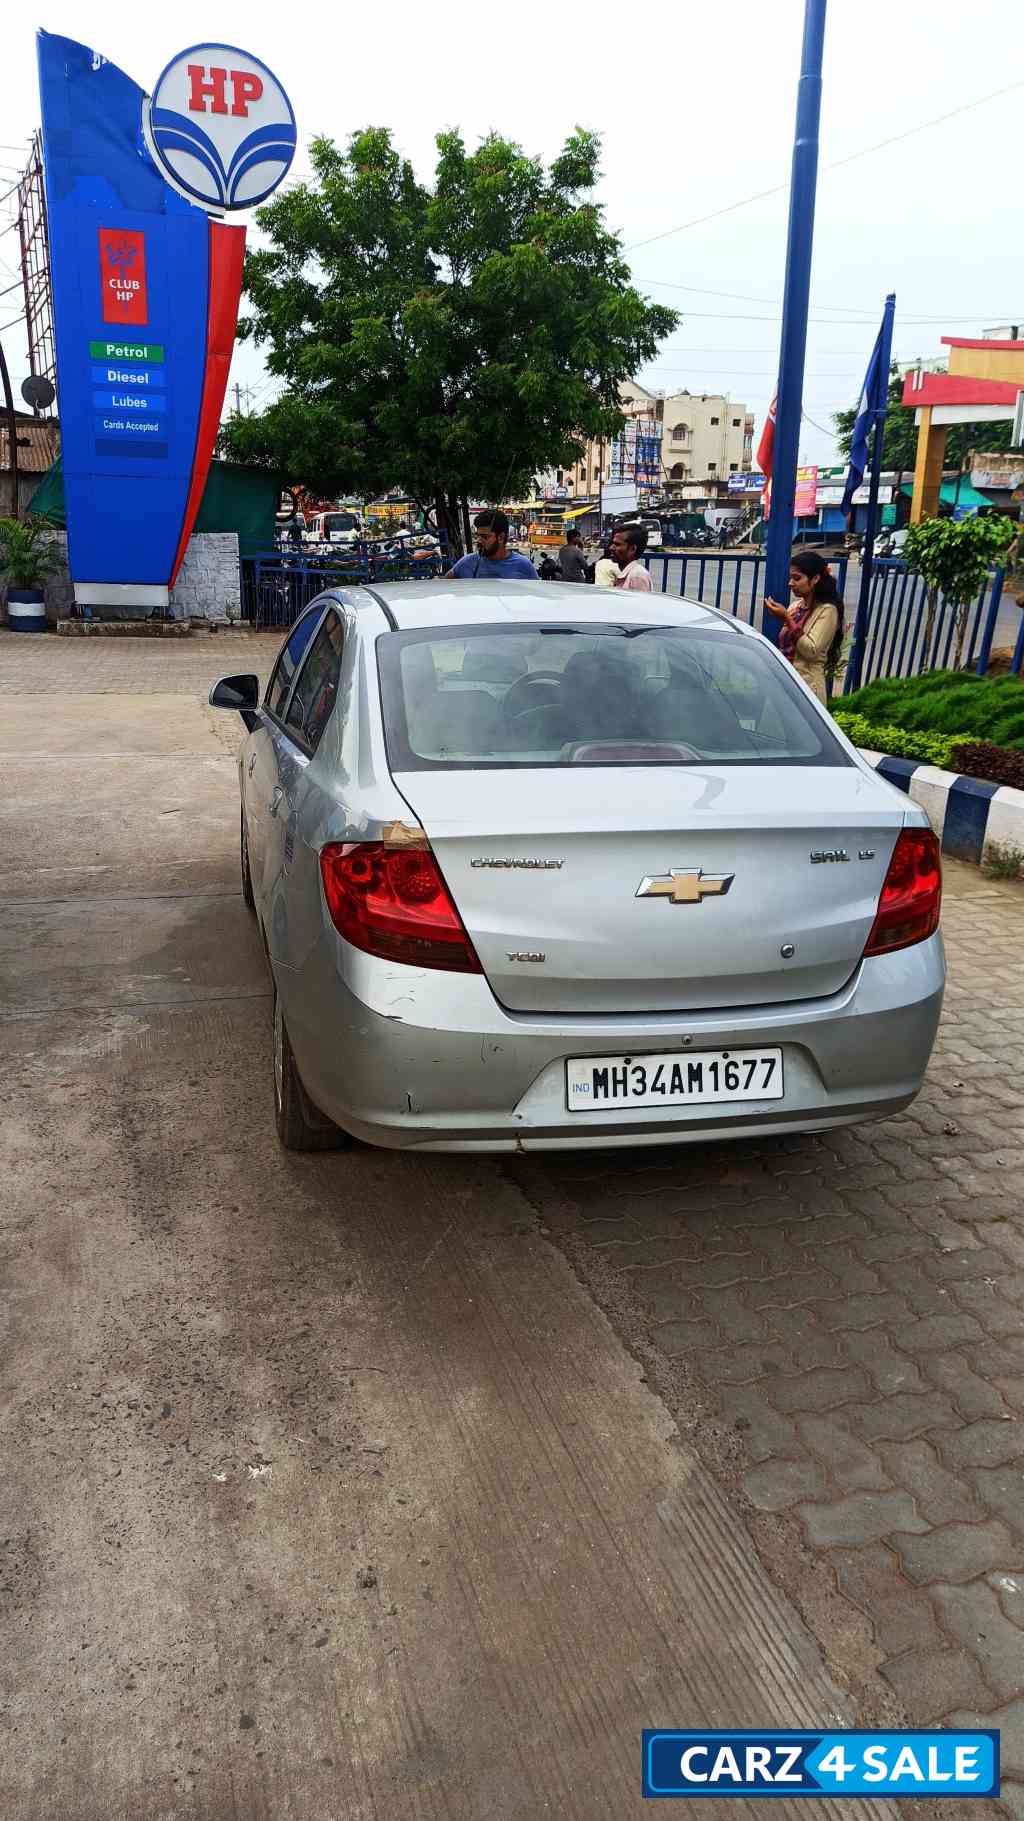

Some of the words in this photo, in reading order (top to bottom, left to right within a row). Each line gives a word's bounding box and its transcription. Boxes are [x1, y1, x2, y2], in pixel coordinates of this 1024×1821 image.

[187, 64, 264, 118] HP
[109, 279, 140, 290] CLUB
[116, 291, 134, 301] HP
[106, 344, 148, 358] Petrol
[107, 370, 149, 384] Diesel
[112, 395, 147, 408] Lubes
[103, 420, 125, 430] Cards
[126, 422, 159, 432] Accepted
[810, 849, 850, 864] SAIL
[470, 858, 565, 869] CHEVROLET
[592, 1058, 776, 1099] MH34AM1677
[572, 1083, 590, 1093] IND
